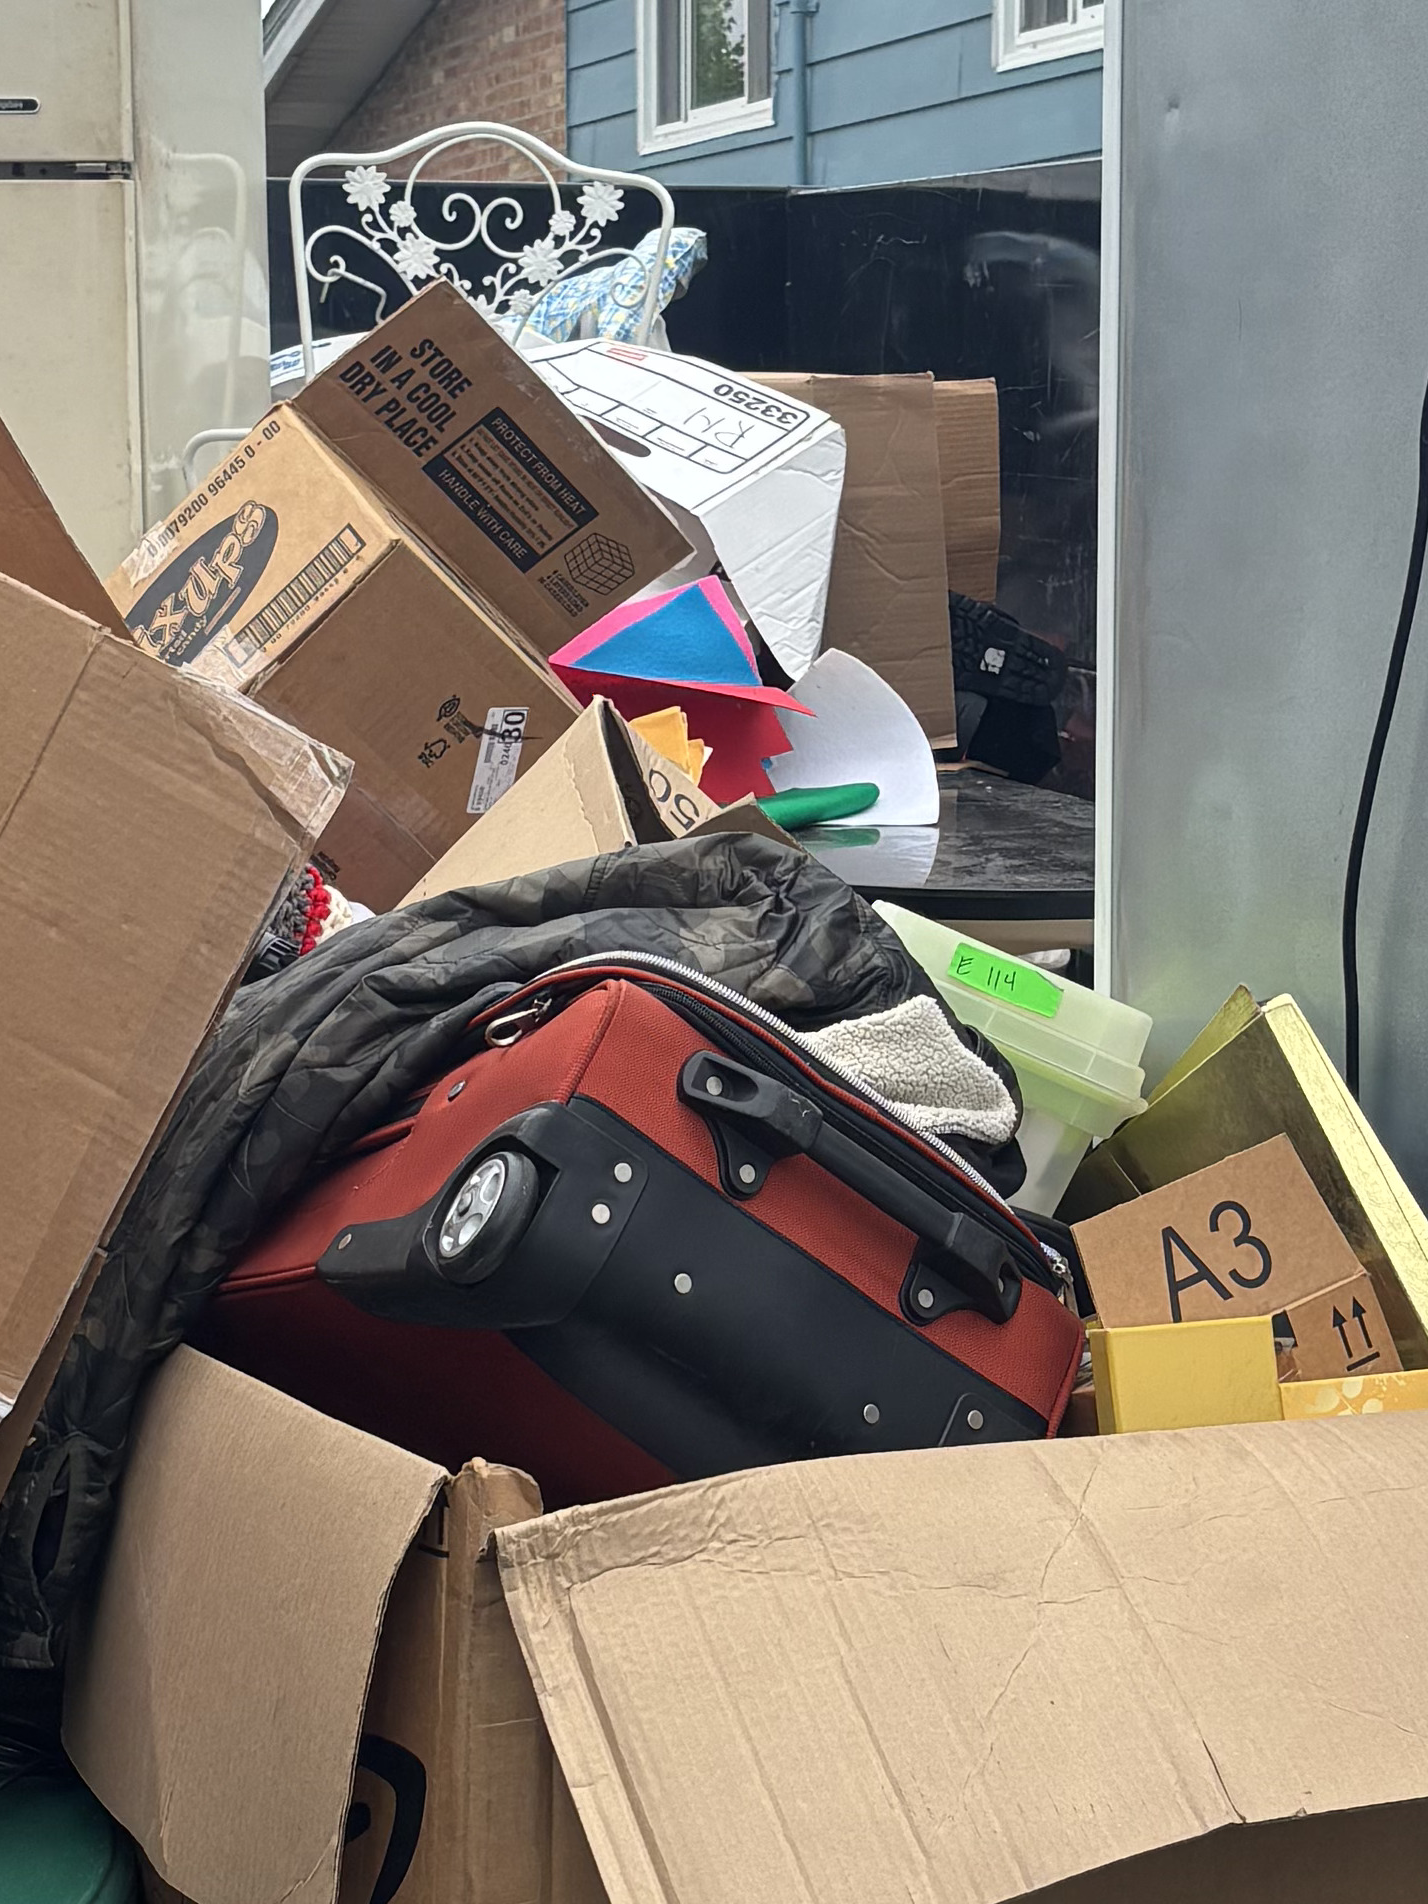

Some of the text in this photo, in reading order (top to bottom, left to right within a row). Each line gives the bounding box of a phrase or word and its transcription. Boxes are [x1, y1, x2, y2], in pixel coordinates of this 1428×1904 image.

[339, 360, 439, 458] DRY PLACE
[370, 345, 457, 433] IN A COOL
[410, 338, 472, 400] STORE
[713, 383, 799, 425] 33250
[207, 458, 246, 497] 96445
[245, 444, 256, 460] 0
[262, 420, 281, 441] 00
[491, 416, 588, 516] PROTECT FROM HEAT
[438, 469, 528, 559] HANDLE WITH CARE
[956, 956, 1017, 992] E 114
[1160, 1200, 1272, 1324] A3
